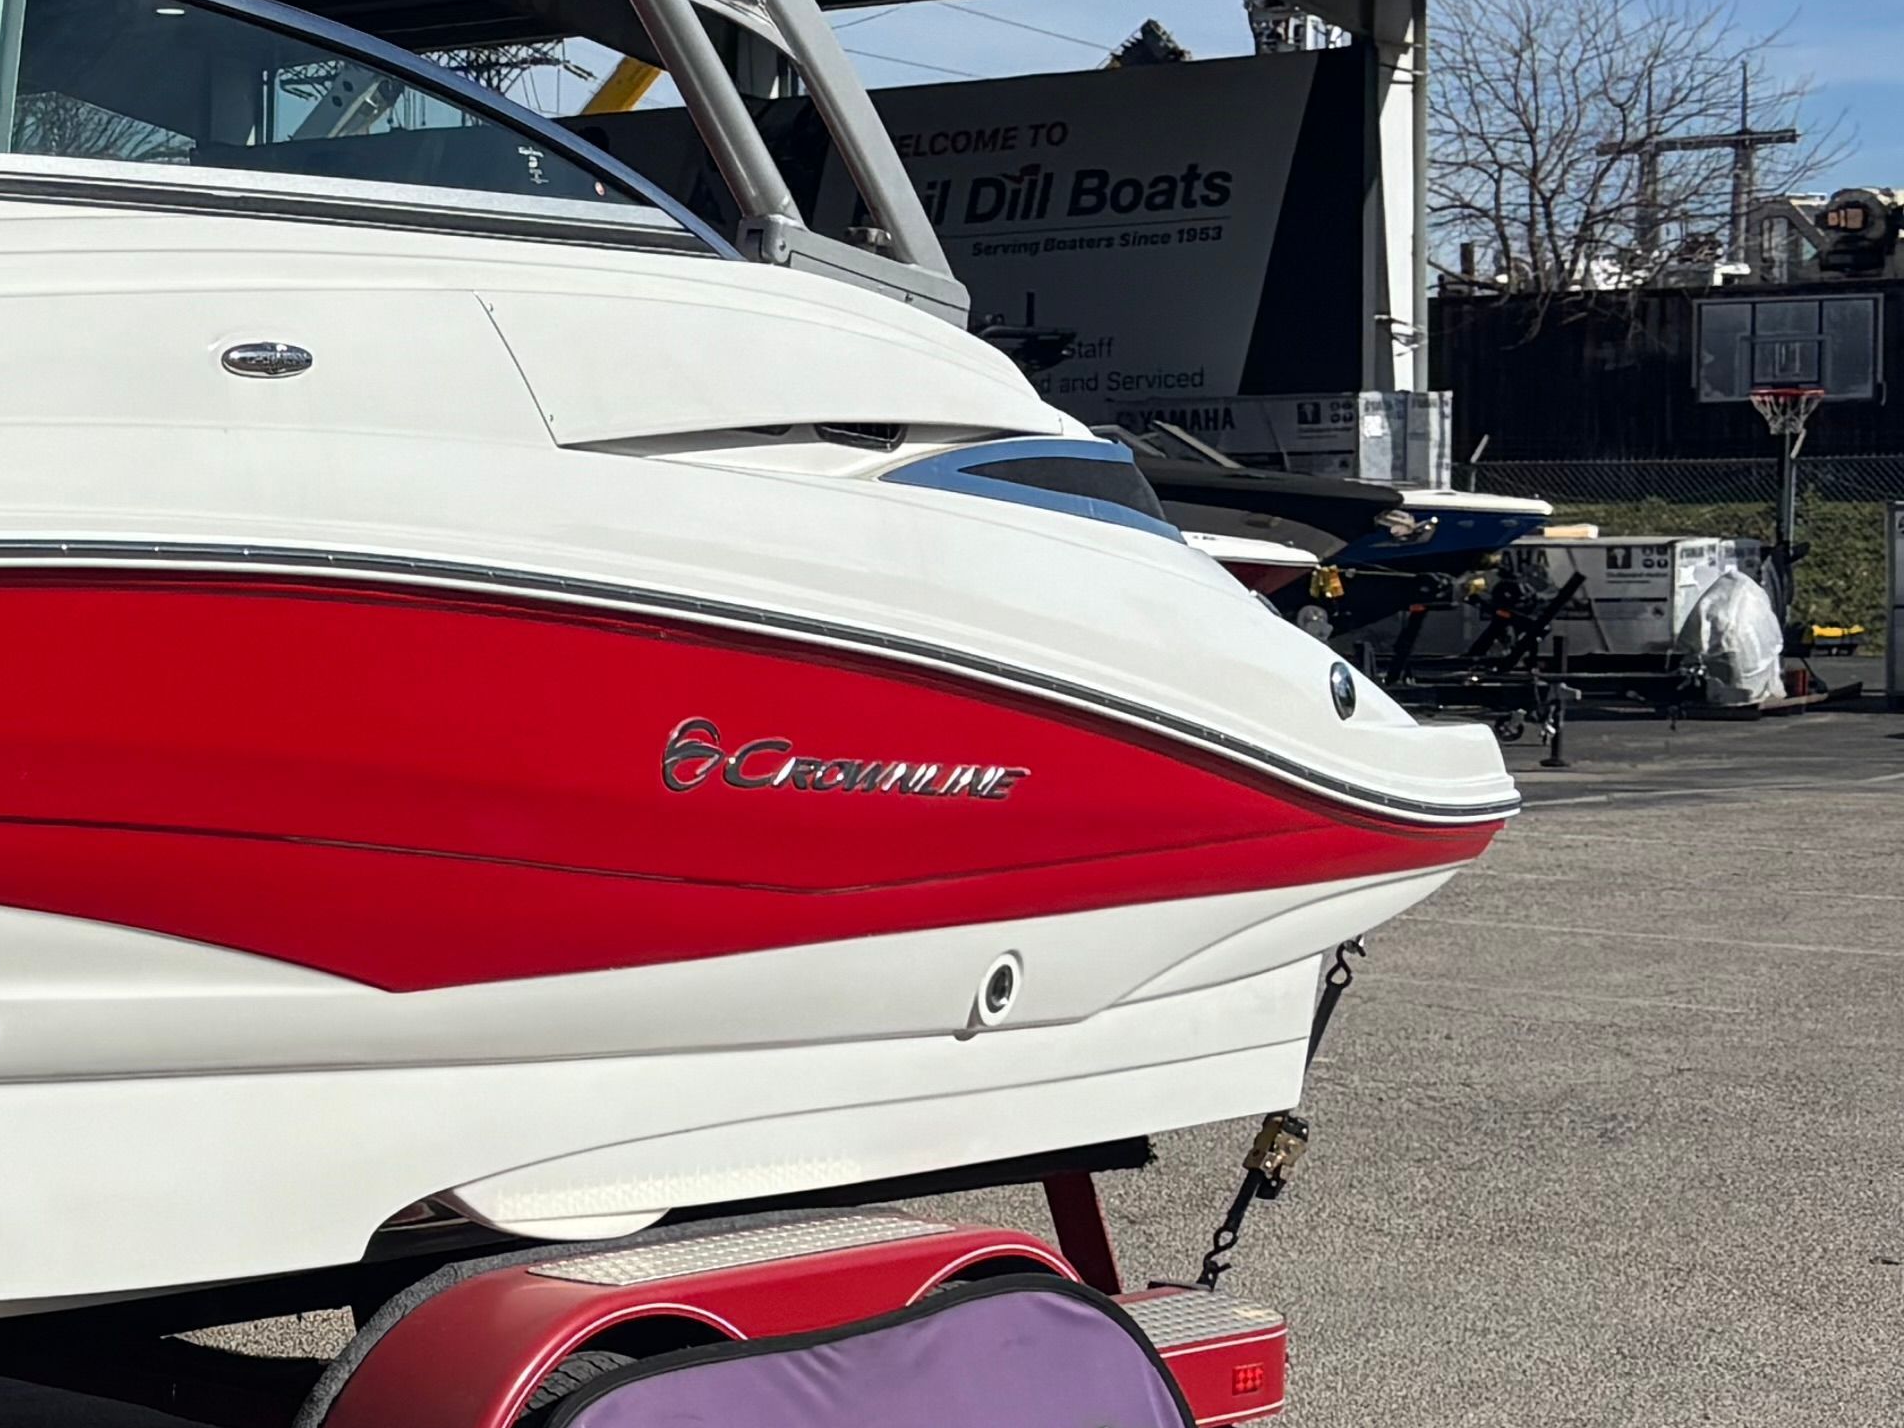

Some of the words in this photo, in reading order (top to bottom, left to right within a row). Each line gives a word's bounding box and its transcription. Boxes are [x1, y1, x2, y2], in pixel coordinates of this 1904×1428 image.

[896, 127, 1019, 158] ELCOME
[1029, 121, 1069, 148] TO
[965, 172, 1054, 224] Dill
[1068, 163, 1233, 218] Boats
[972, 239, 1040, 257] Serving
[1044, 235, 1114, 253] Boaters
[1120, 231, 1171, 249] Since
[1177, 226, 1223, 244] 1953
[1059, 372, 1098, 393] and
[1107, 365, 1205, 392] Serviced
